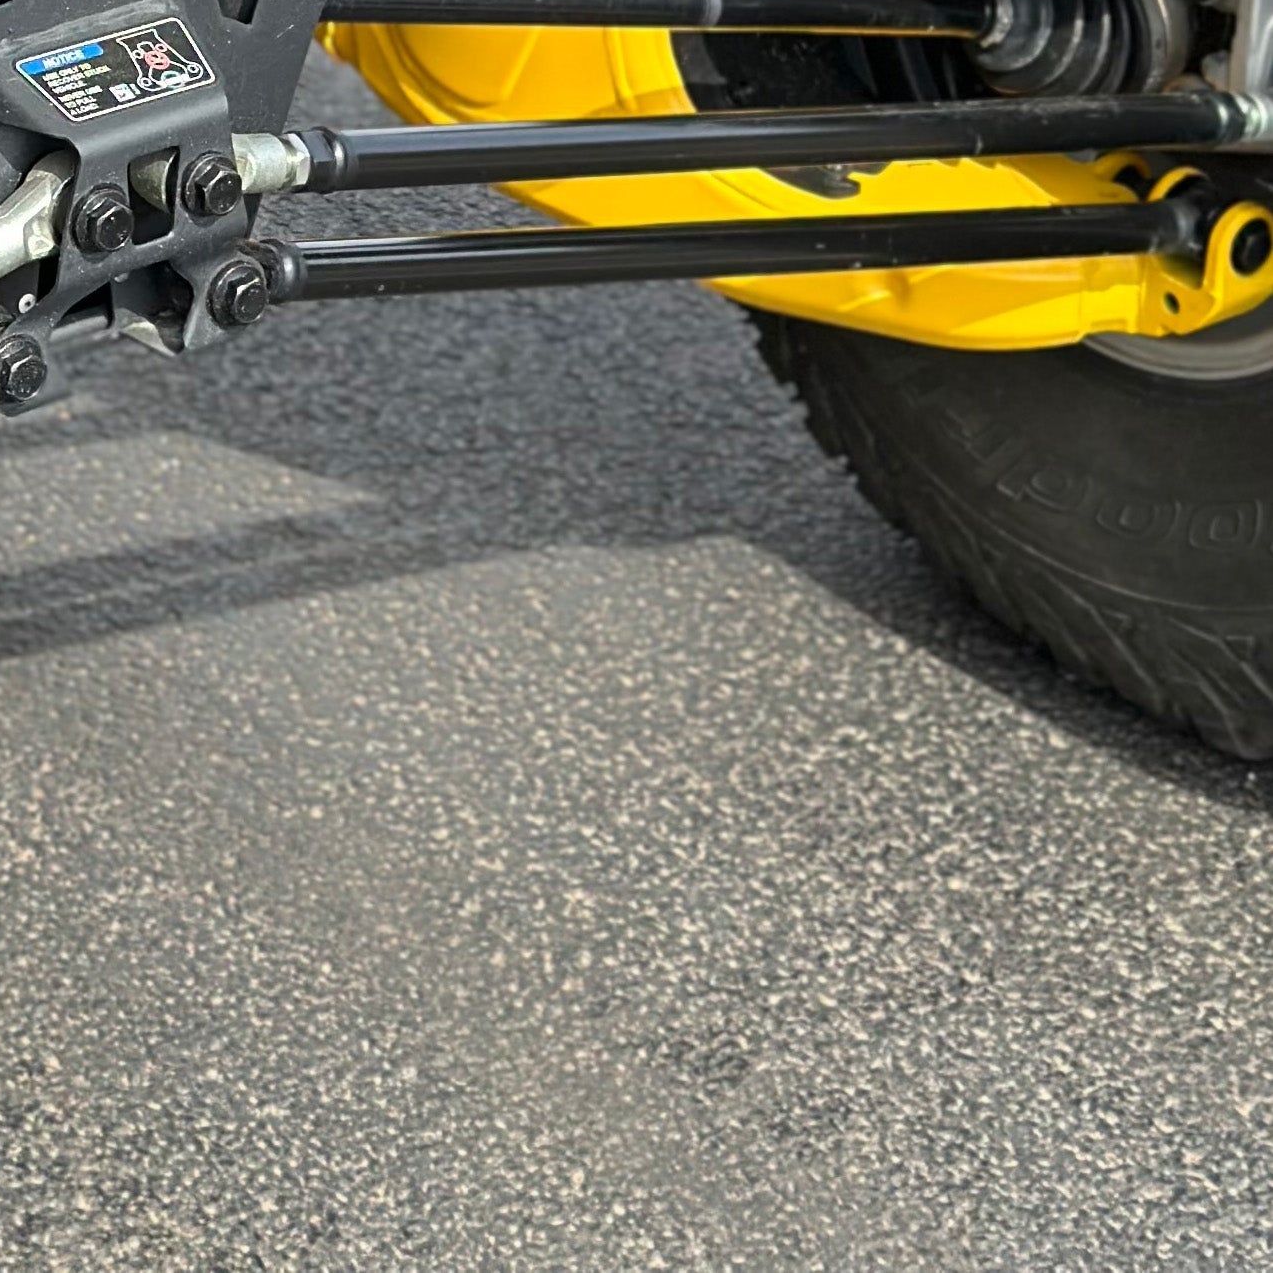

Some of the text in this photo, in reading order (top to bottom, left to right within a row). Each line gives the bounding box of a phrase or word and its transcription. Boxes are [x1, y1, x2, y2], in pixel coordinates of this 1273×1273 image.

[42, 49, 85, 70] NOTICE
[59, 66, 79, 77] ONLY
[79, 63, 92, 71] TO
[47, 72, 86, 88] RECOVER
[75, 95, 97, 106] PULL
